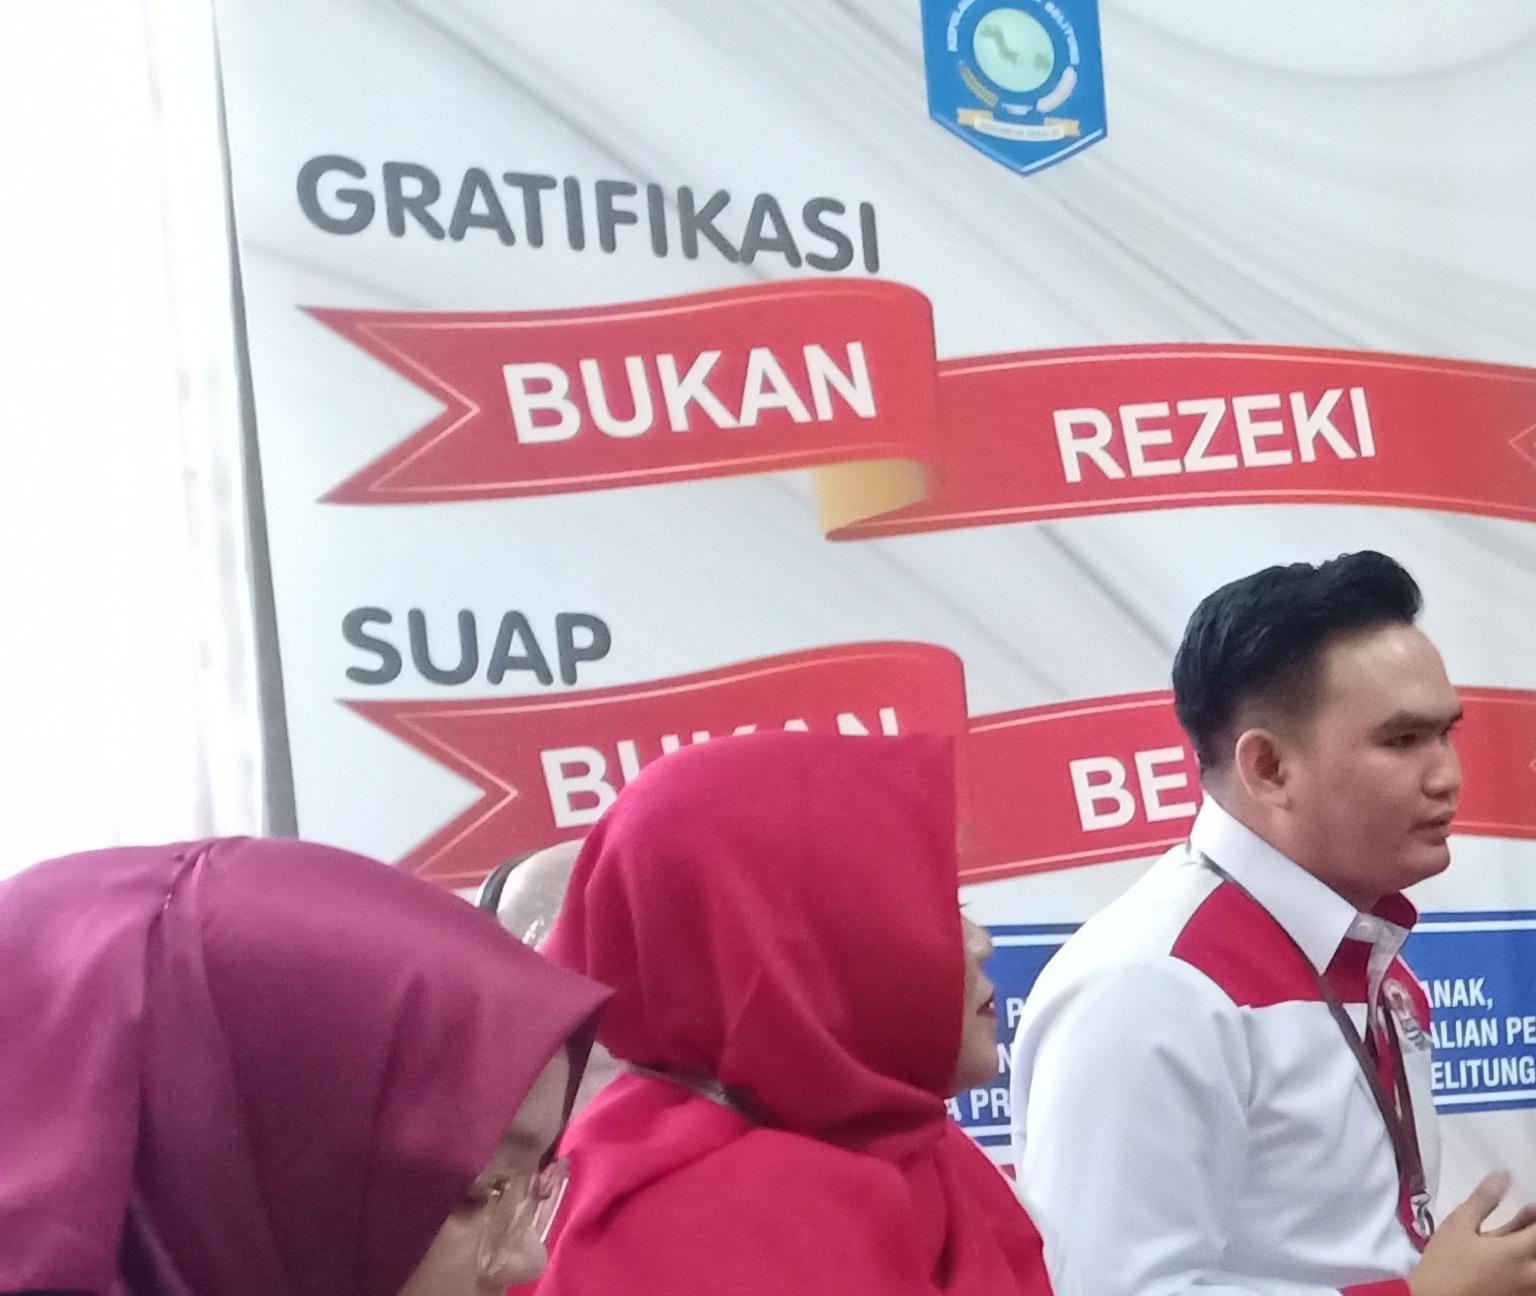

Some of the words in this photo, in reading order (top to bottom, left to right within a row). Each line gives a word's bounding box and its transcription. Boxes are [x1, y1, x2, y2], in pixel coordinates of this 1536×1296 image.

[297, 154, 880, 274] GRATIFIKASI
[502, 341, 877, 444] BUKAN
[1052, 387, 1376, 483] REZEKI
[342, 606, 612, 686] SUAP
